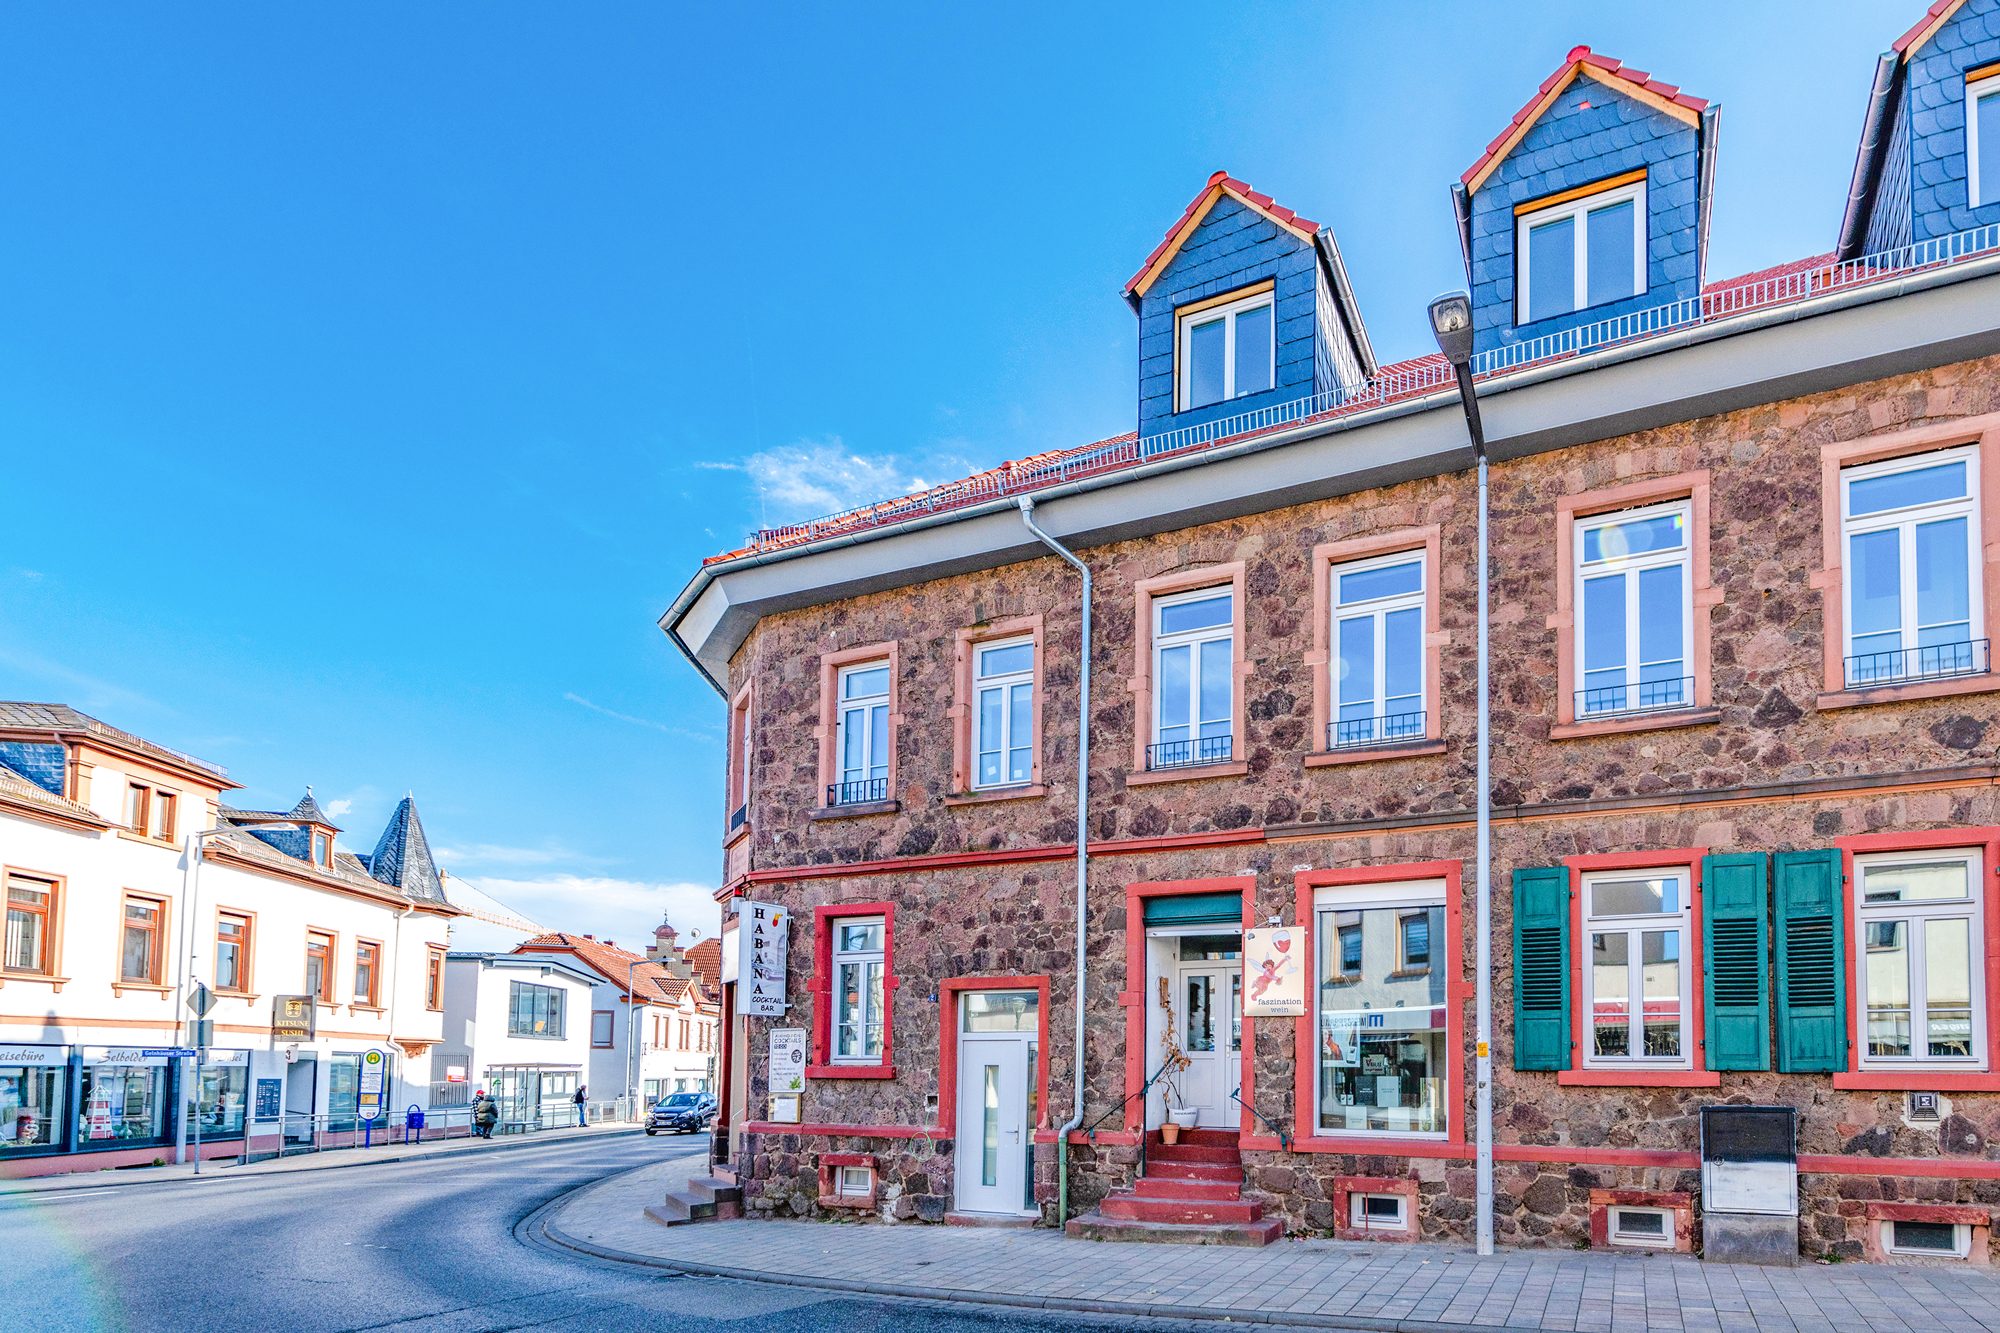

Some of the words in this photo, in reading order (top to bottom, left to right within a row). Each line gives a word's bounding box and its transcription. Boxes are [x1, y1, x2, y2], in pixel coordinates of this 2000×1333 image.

[753, 907, 765, 995] HABANA
[752, 996, 784, 1005] COCKTAIL
[1258, 998, 1302, 1006] faszination
[760, 1004, 775, 1012] BAR
[0, 1049, 45, 1061] eisebüro
